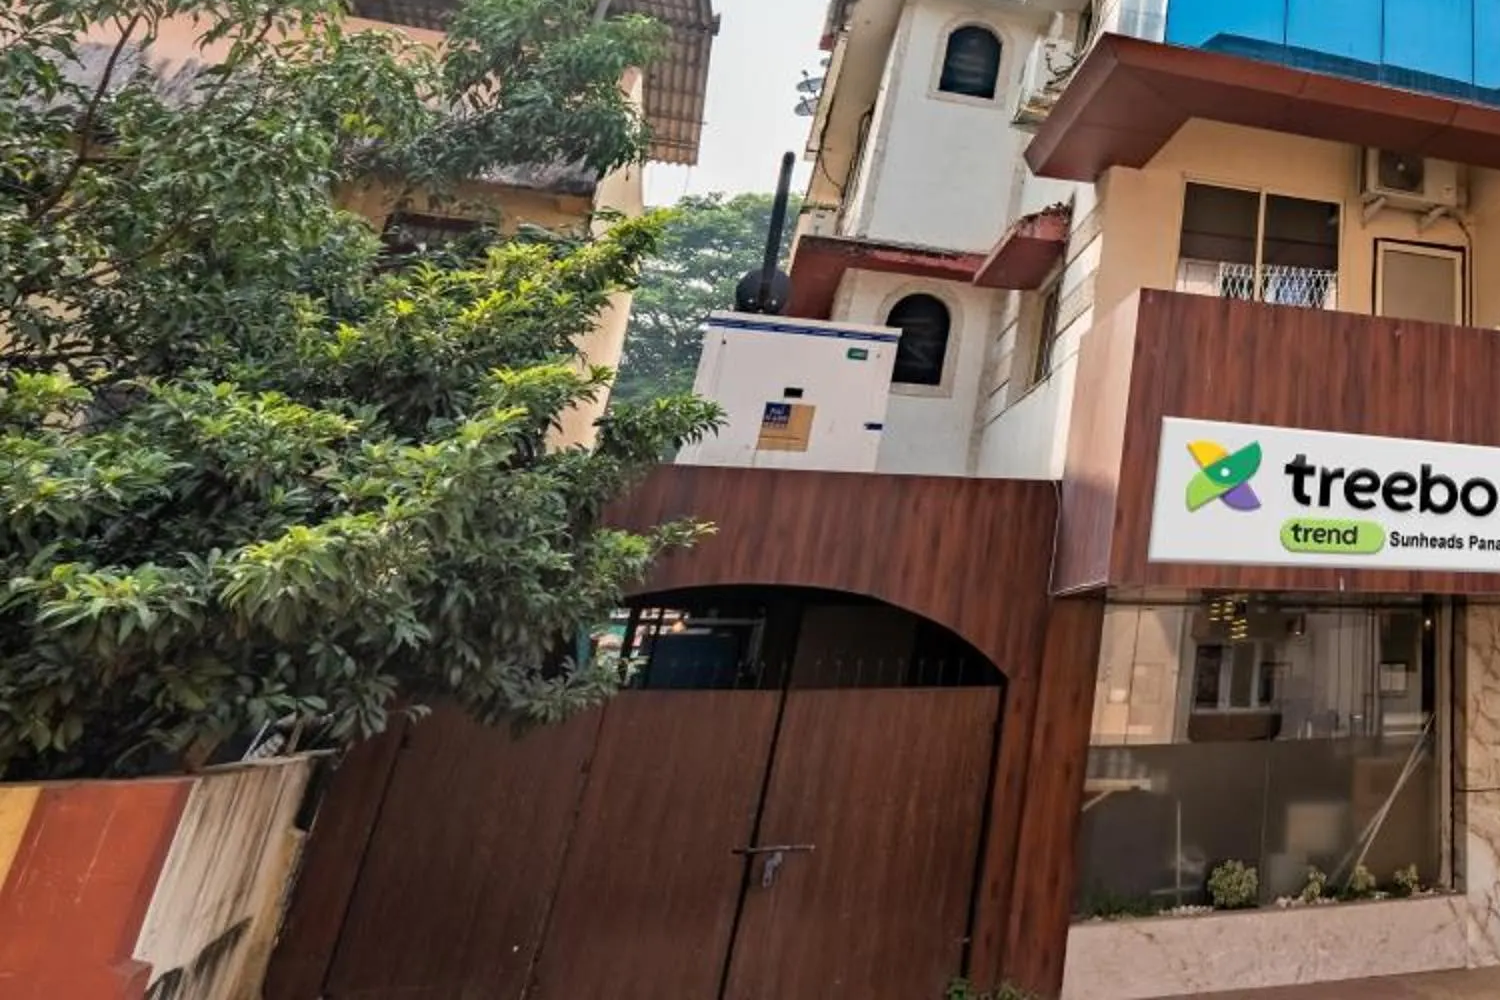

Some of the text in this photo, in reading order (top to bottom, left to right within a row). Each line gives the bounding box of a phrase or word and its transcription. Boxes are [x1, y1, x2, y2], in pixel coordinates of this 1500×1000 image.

[1284, 454, 1498, 517] treebo
[1290, 523, 1359, 545] trend
[1389, 531, 1464, 550] Sunheads
